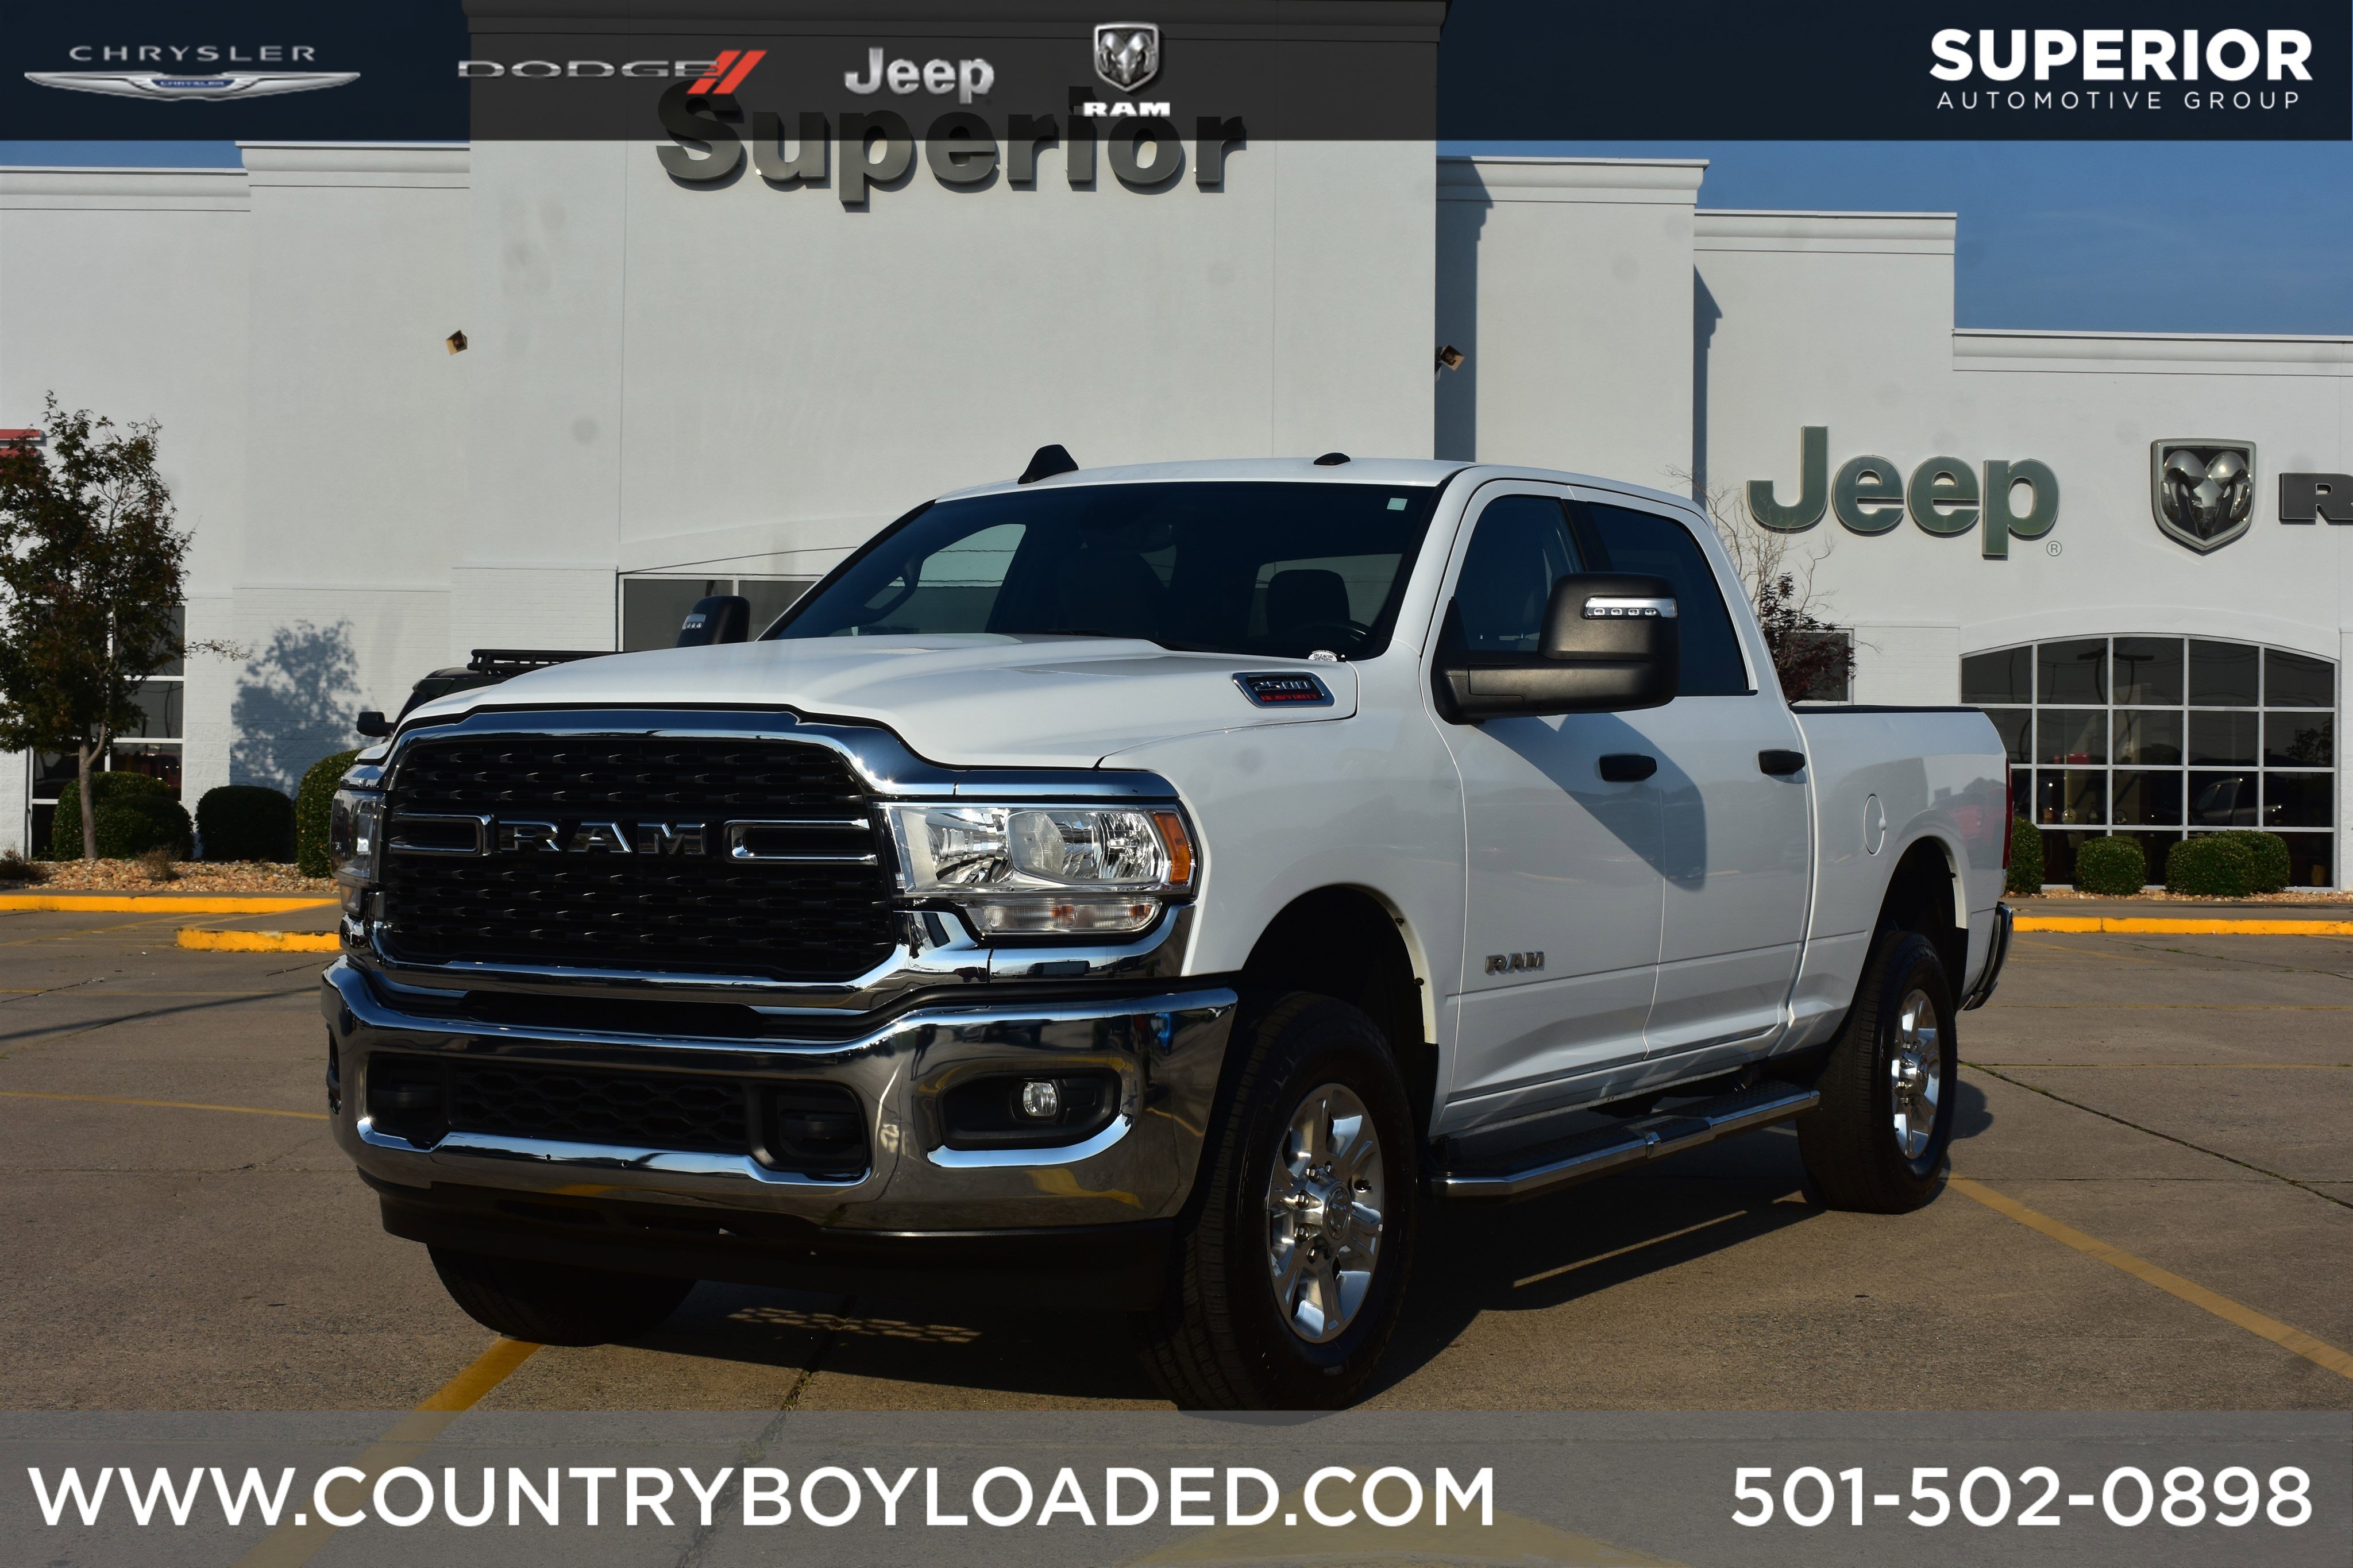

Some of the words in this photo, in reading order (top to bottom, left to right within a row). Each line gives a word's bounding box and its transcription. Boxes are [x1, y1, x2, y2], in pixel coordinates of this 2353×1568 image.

[655, 81, 1243, 207] Superior
[1746, 426, 2060, 557] Jeep
[499, 820, 707, 856] RAM
[1484, 951, 1544, 973] RAM
